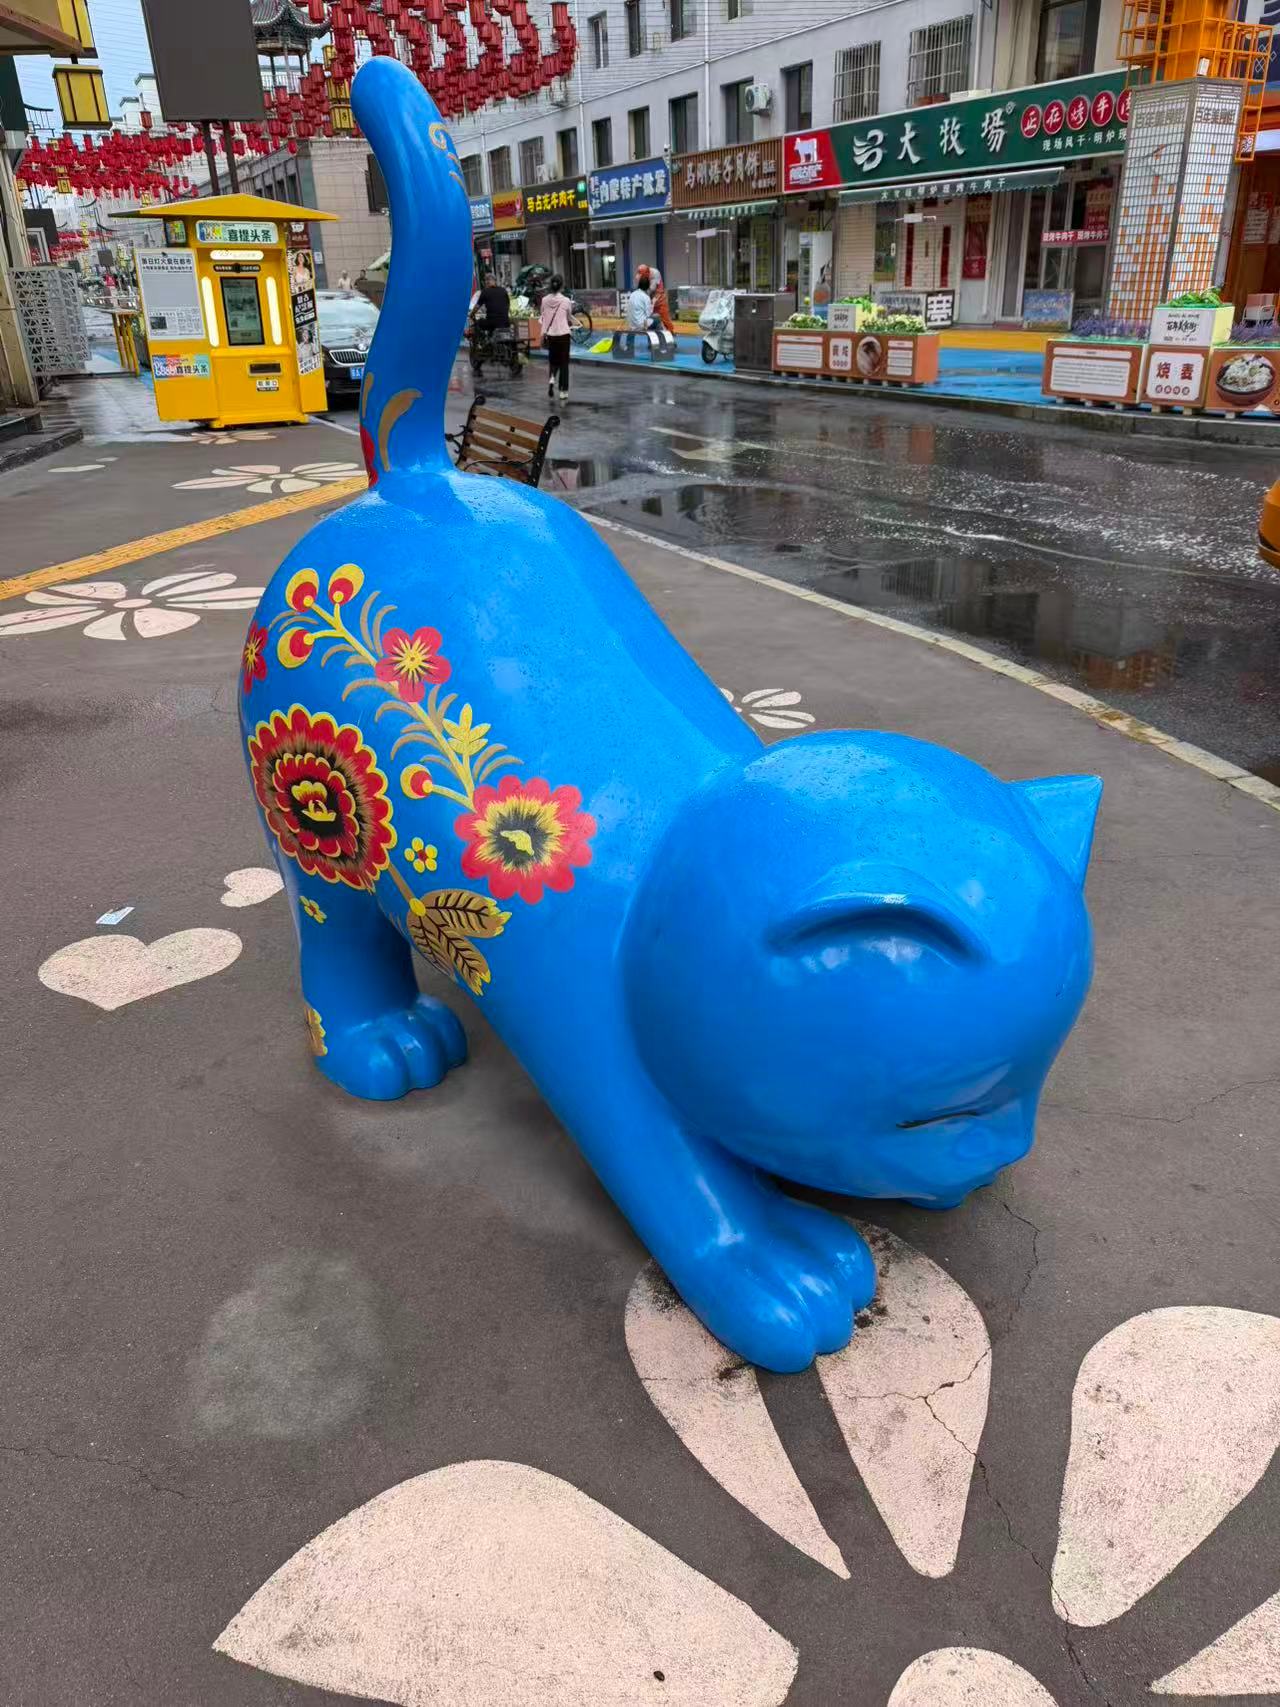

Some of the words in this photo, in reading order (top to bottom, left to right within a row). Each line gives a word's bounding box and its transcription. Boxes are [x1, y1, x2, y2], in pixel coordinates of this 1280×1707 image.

[227, 229, 272, 243] 喜提头条
[176, 363, 209, 374] 喜提头条
